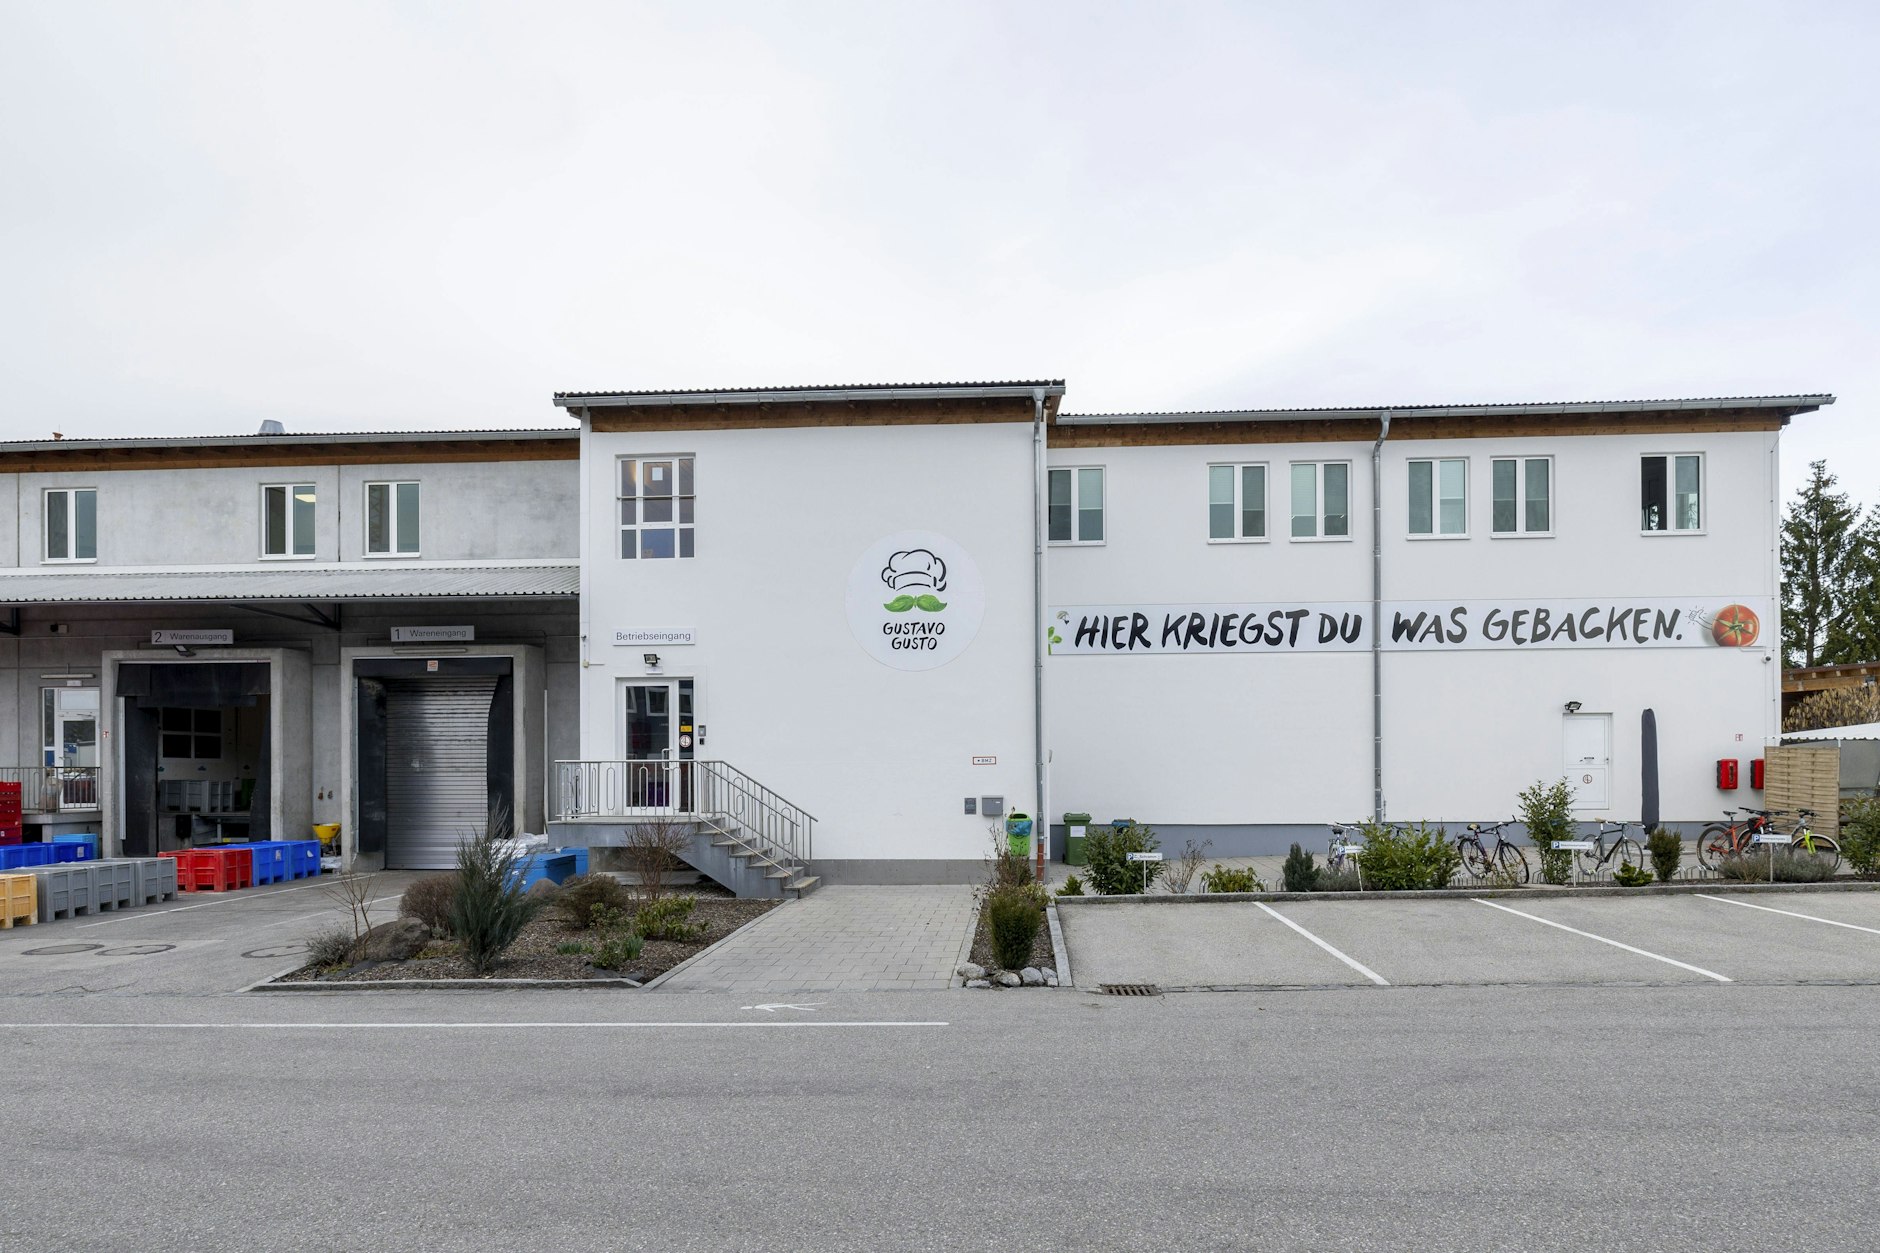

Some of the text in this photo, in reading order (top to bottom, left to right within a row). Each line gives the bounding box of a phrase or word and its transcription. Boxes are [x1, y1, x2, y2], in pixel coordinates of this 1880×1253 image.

[394, 628, 467, 641] 1 Wareneingang
[882, 621, 946, 635] GUSTAVO
[1074, 606, 1684, 651] HIER KRIEGST DU WAS GEBACKEN.
[154, 631, 229, 643] 2 Warenausgang
[615, 630, 691, 644] Betriebseingang
[891, 636, 938, 651] GUSTO
